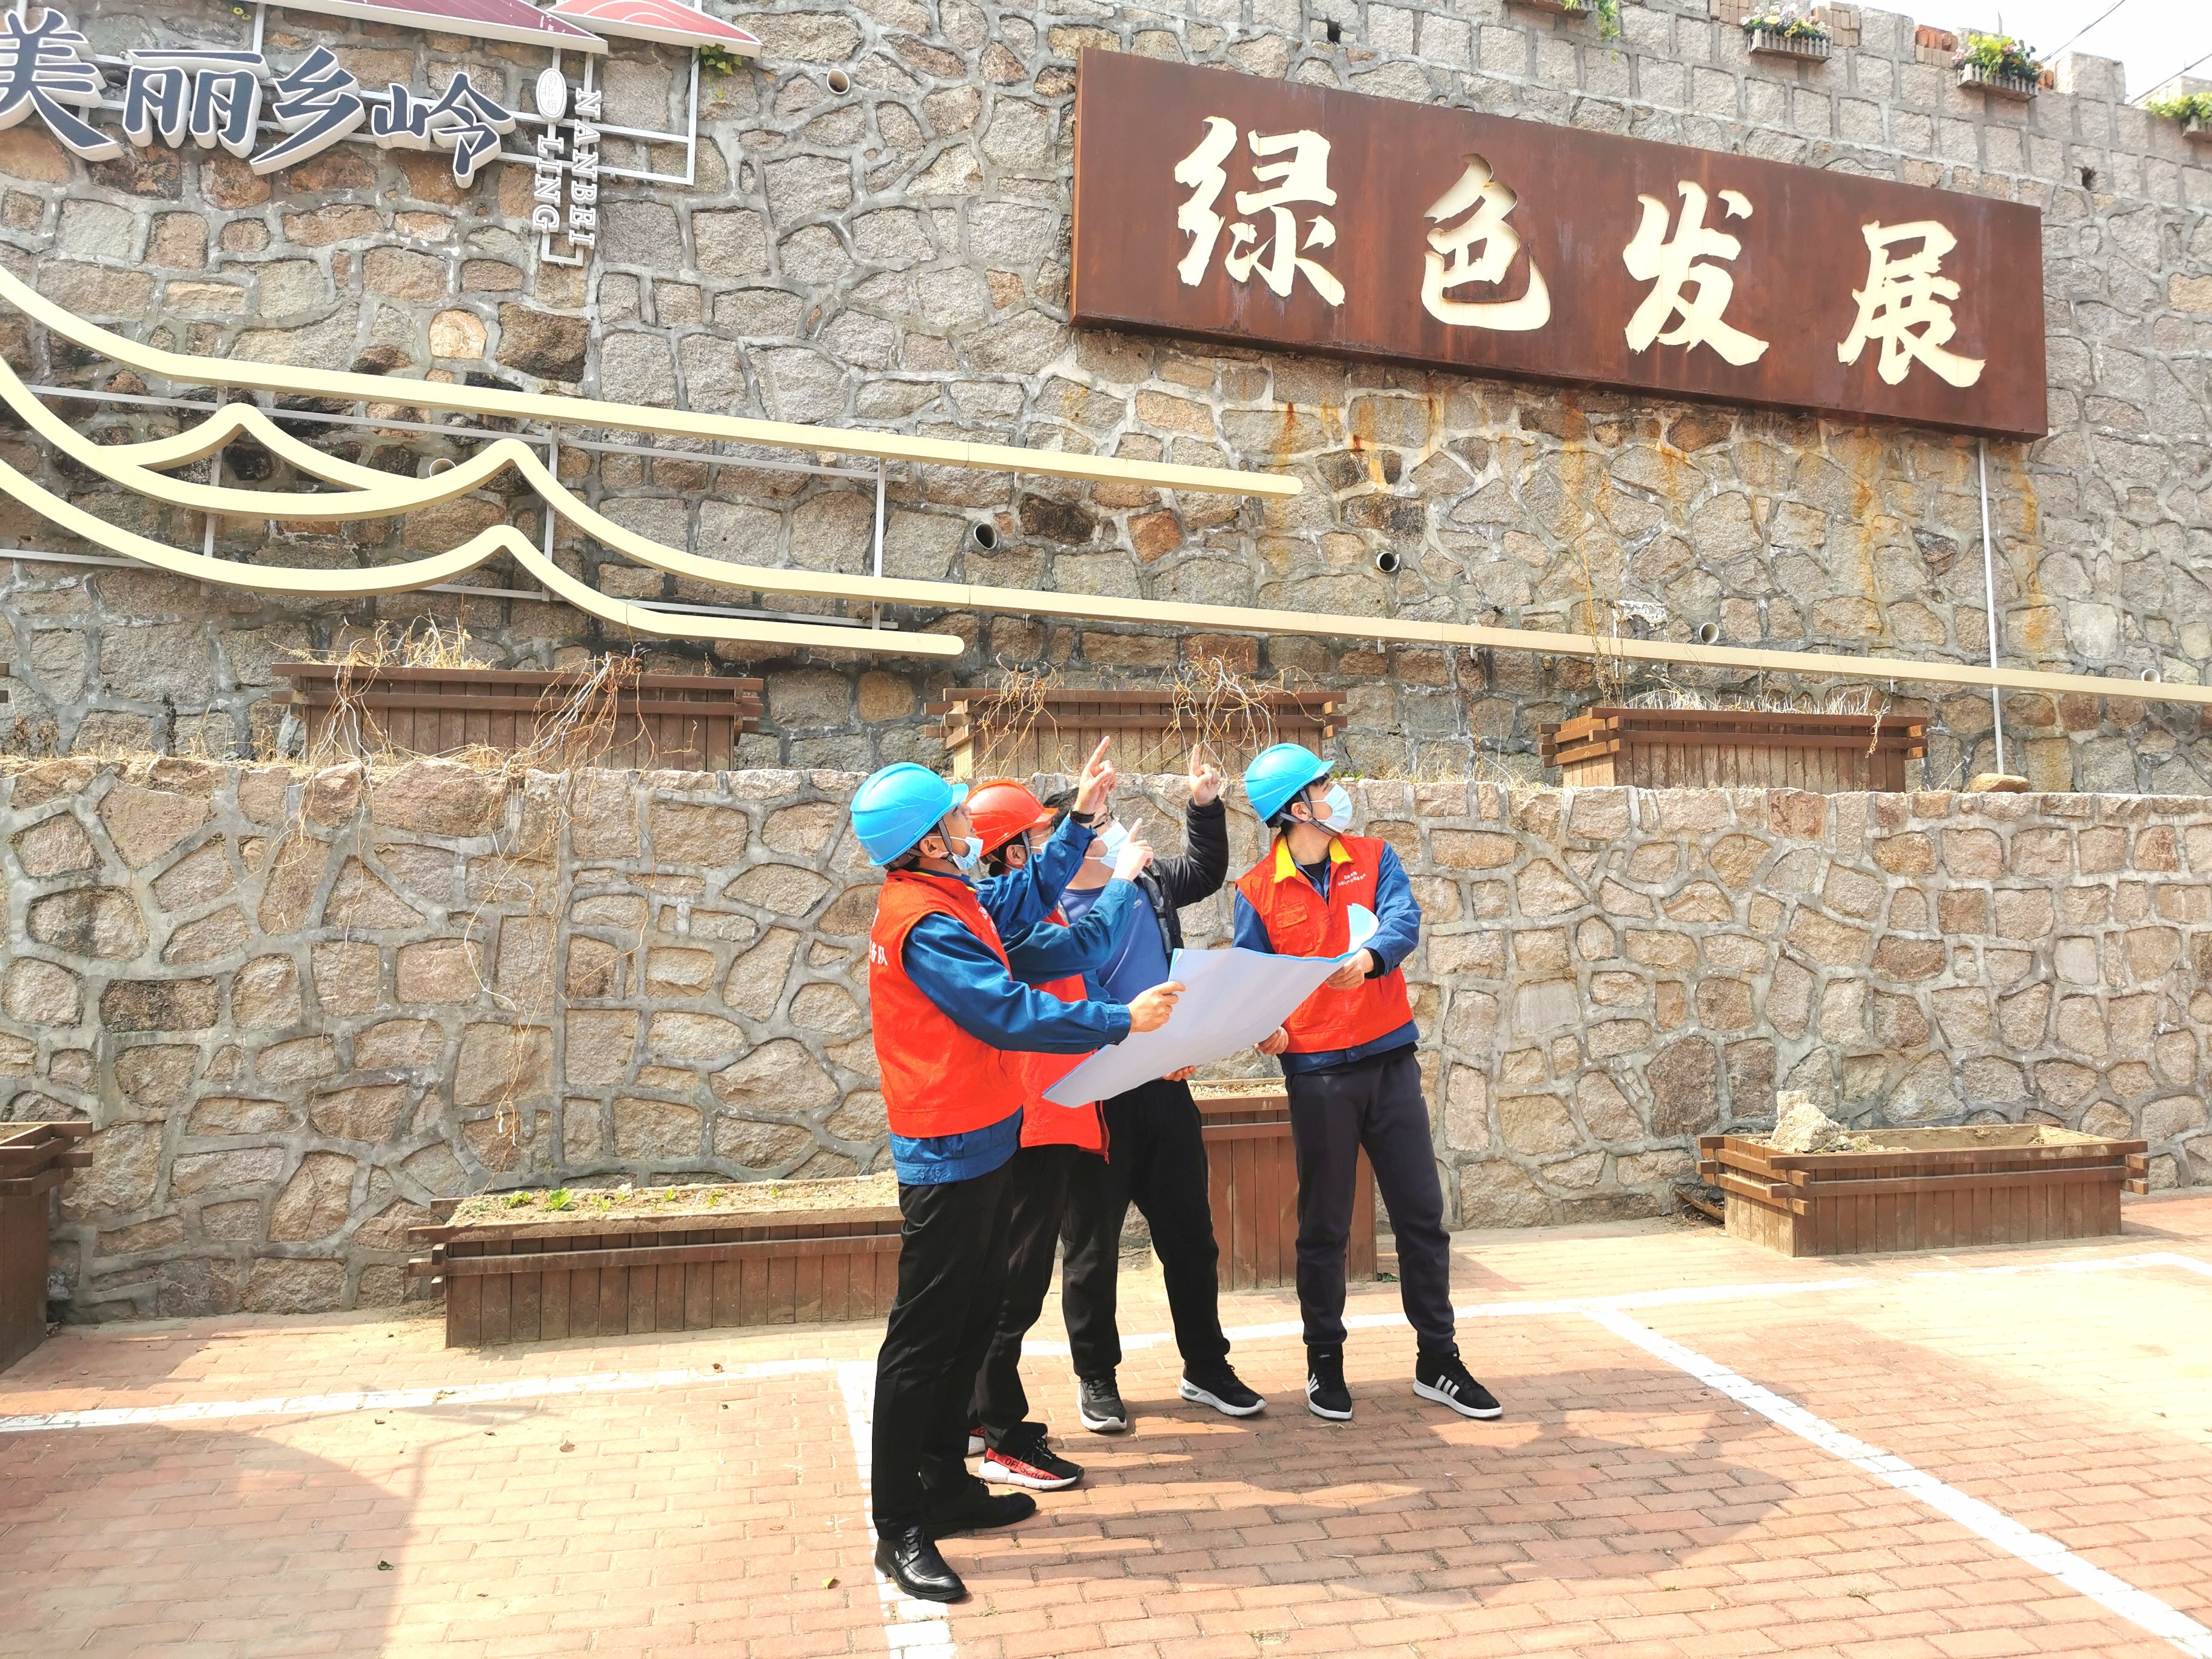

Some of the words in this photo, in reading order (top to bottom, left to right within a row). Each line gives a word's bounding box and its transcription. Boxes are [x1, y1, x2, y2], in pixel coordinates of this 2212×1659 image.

[0, 7, 515, 182] 美丽乡岭
[569, 87, 602, 249] NANBEI
[532, 134, 565, 233] LING
[1174, 115, 1987, 387] 绿色发展
